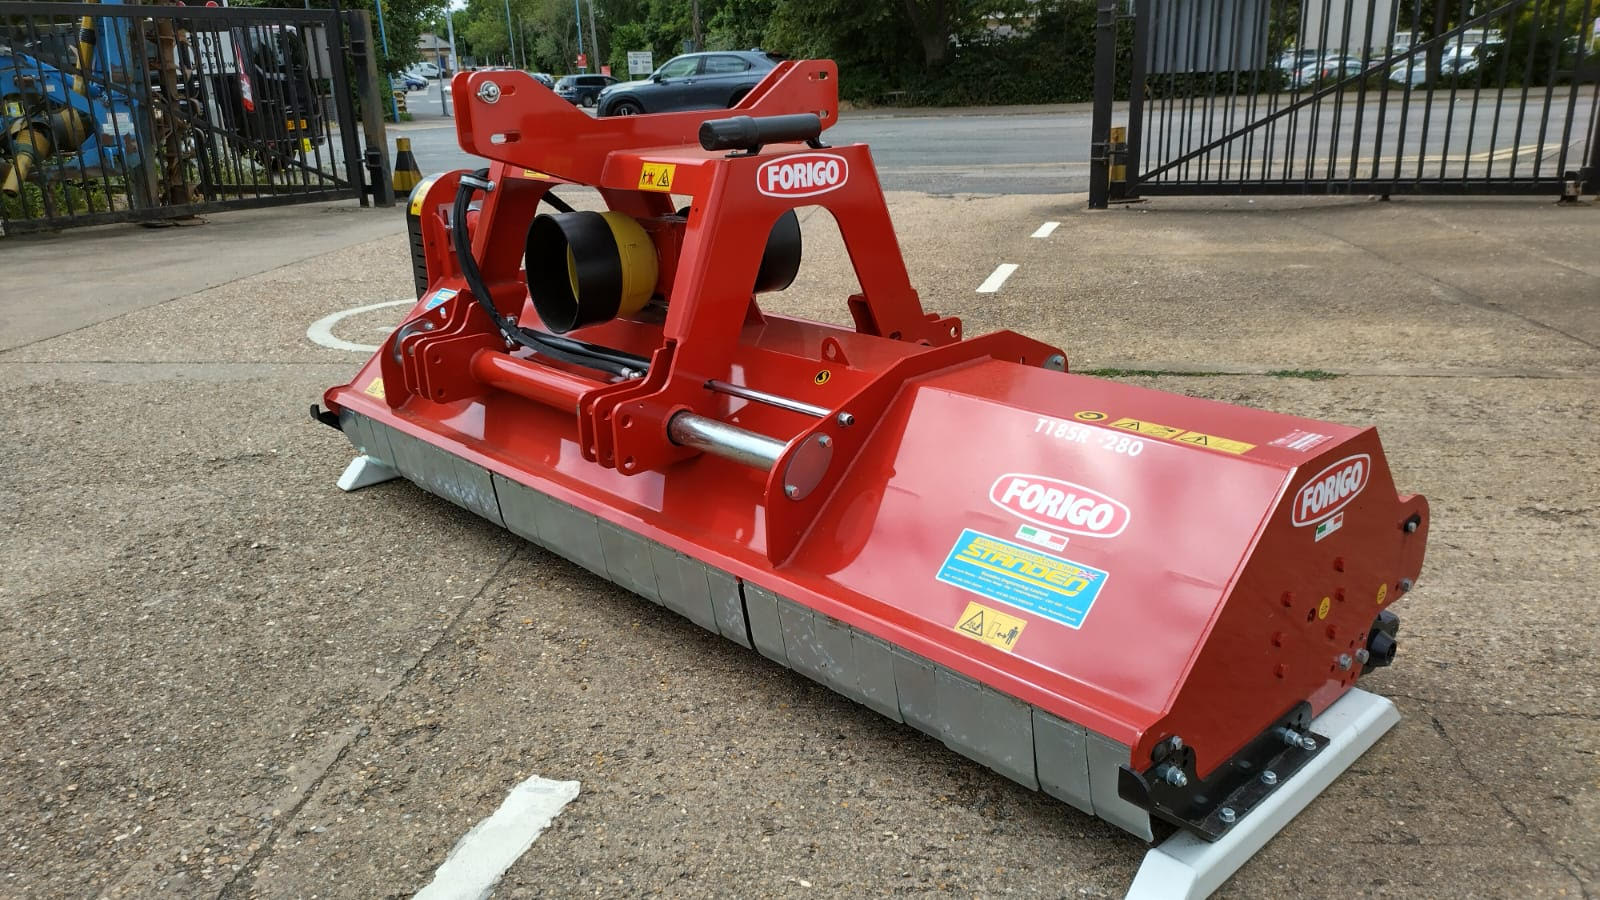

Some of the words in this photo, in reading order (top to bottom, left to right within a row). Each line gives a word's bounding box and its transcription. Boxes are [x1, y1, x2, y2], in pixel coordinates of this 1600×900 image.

[767, 160, 839, 191] FORIGO
[1001, 478, 1114, 531] FORIGO
[1301, 461, 1363, 520] FORIGO
